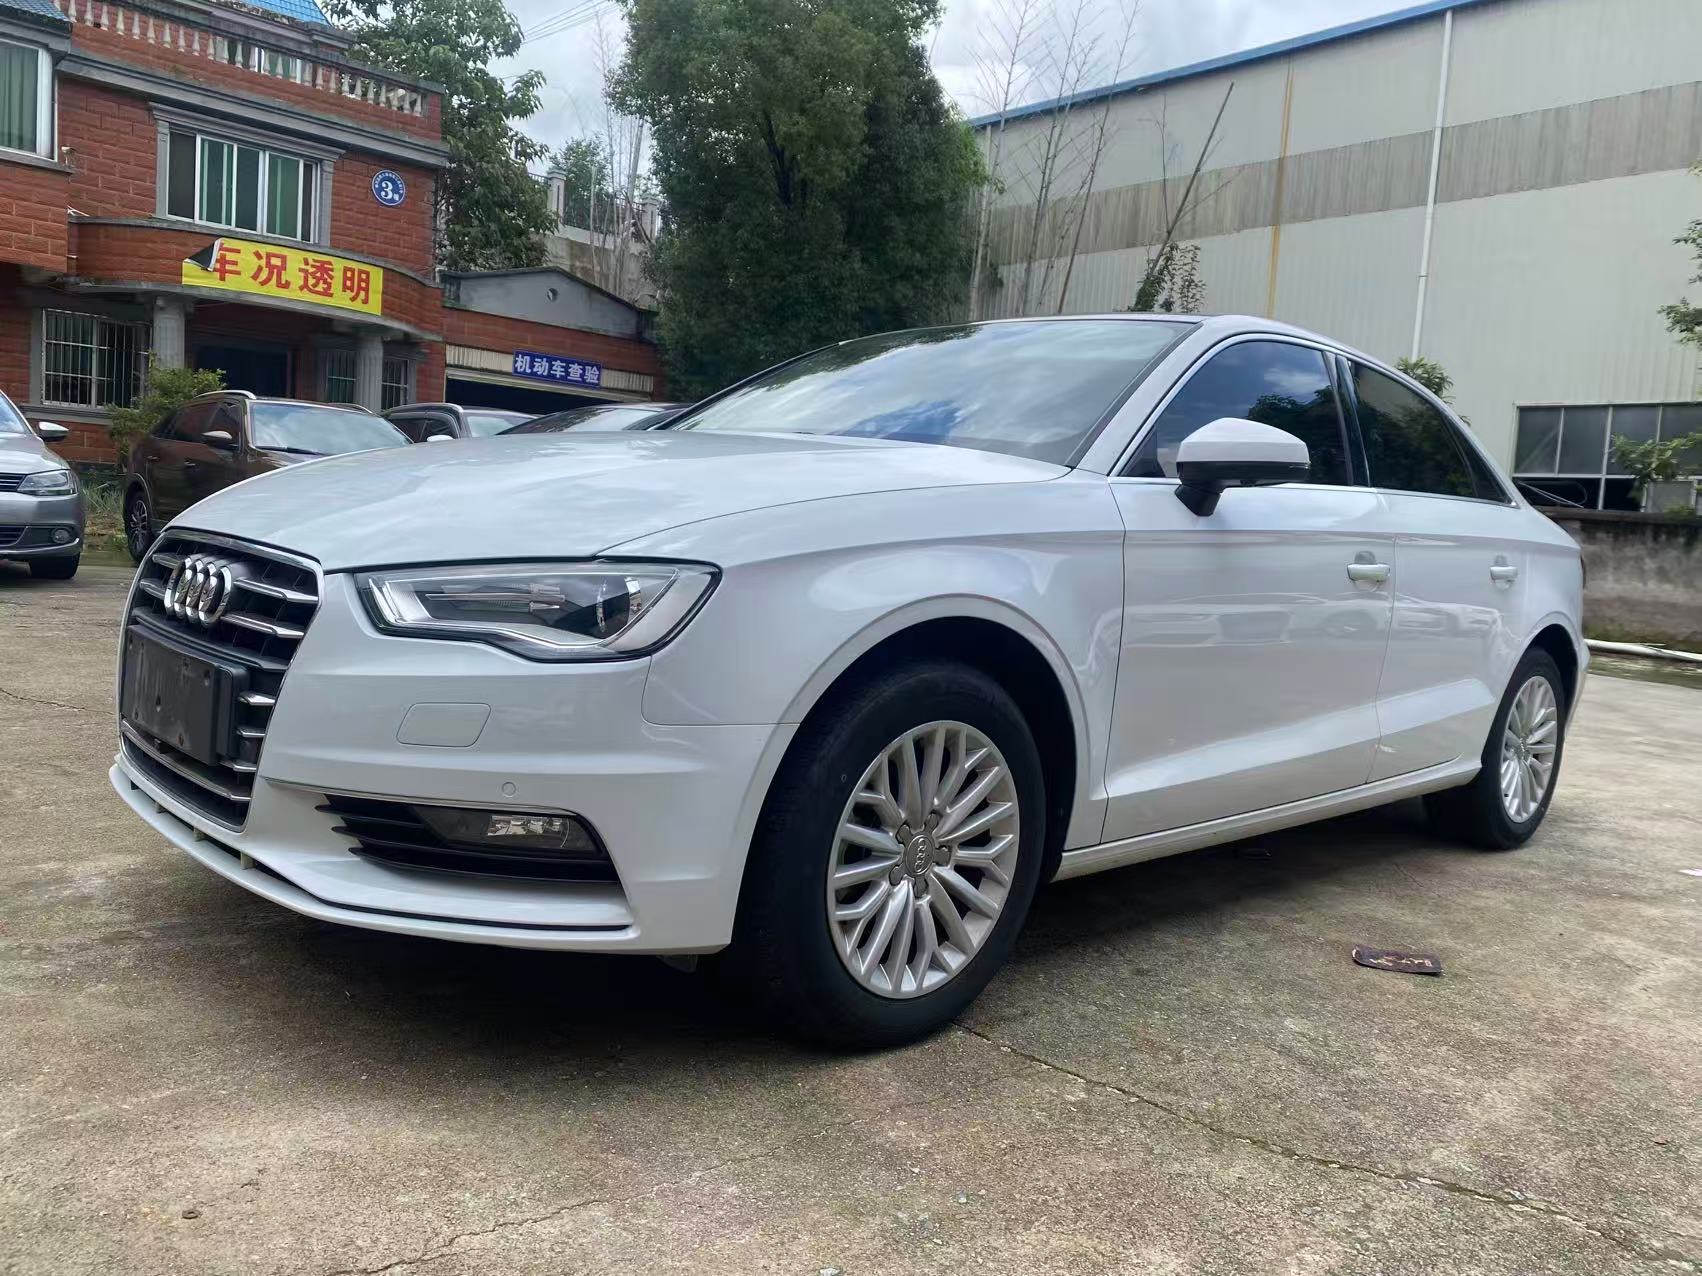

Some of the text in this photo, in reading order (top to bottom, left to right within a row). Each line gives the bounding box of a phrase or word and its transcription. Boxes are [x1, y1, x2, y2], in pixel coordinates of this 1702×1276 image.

[515, 354, 599, 383] 机动车查验
